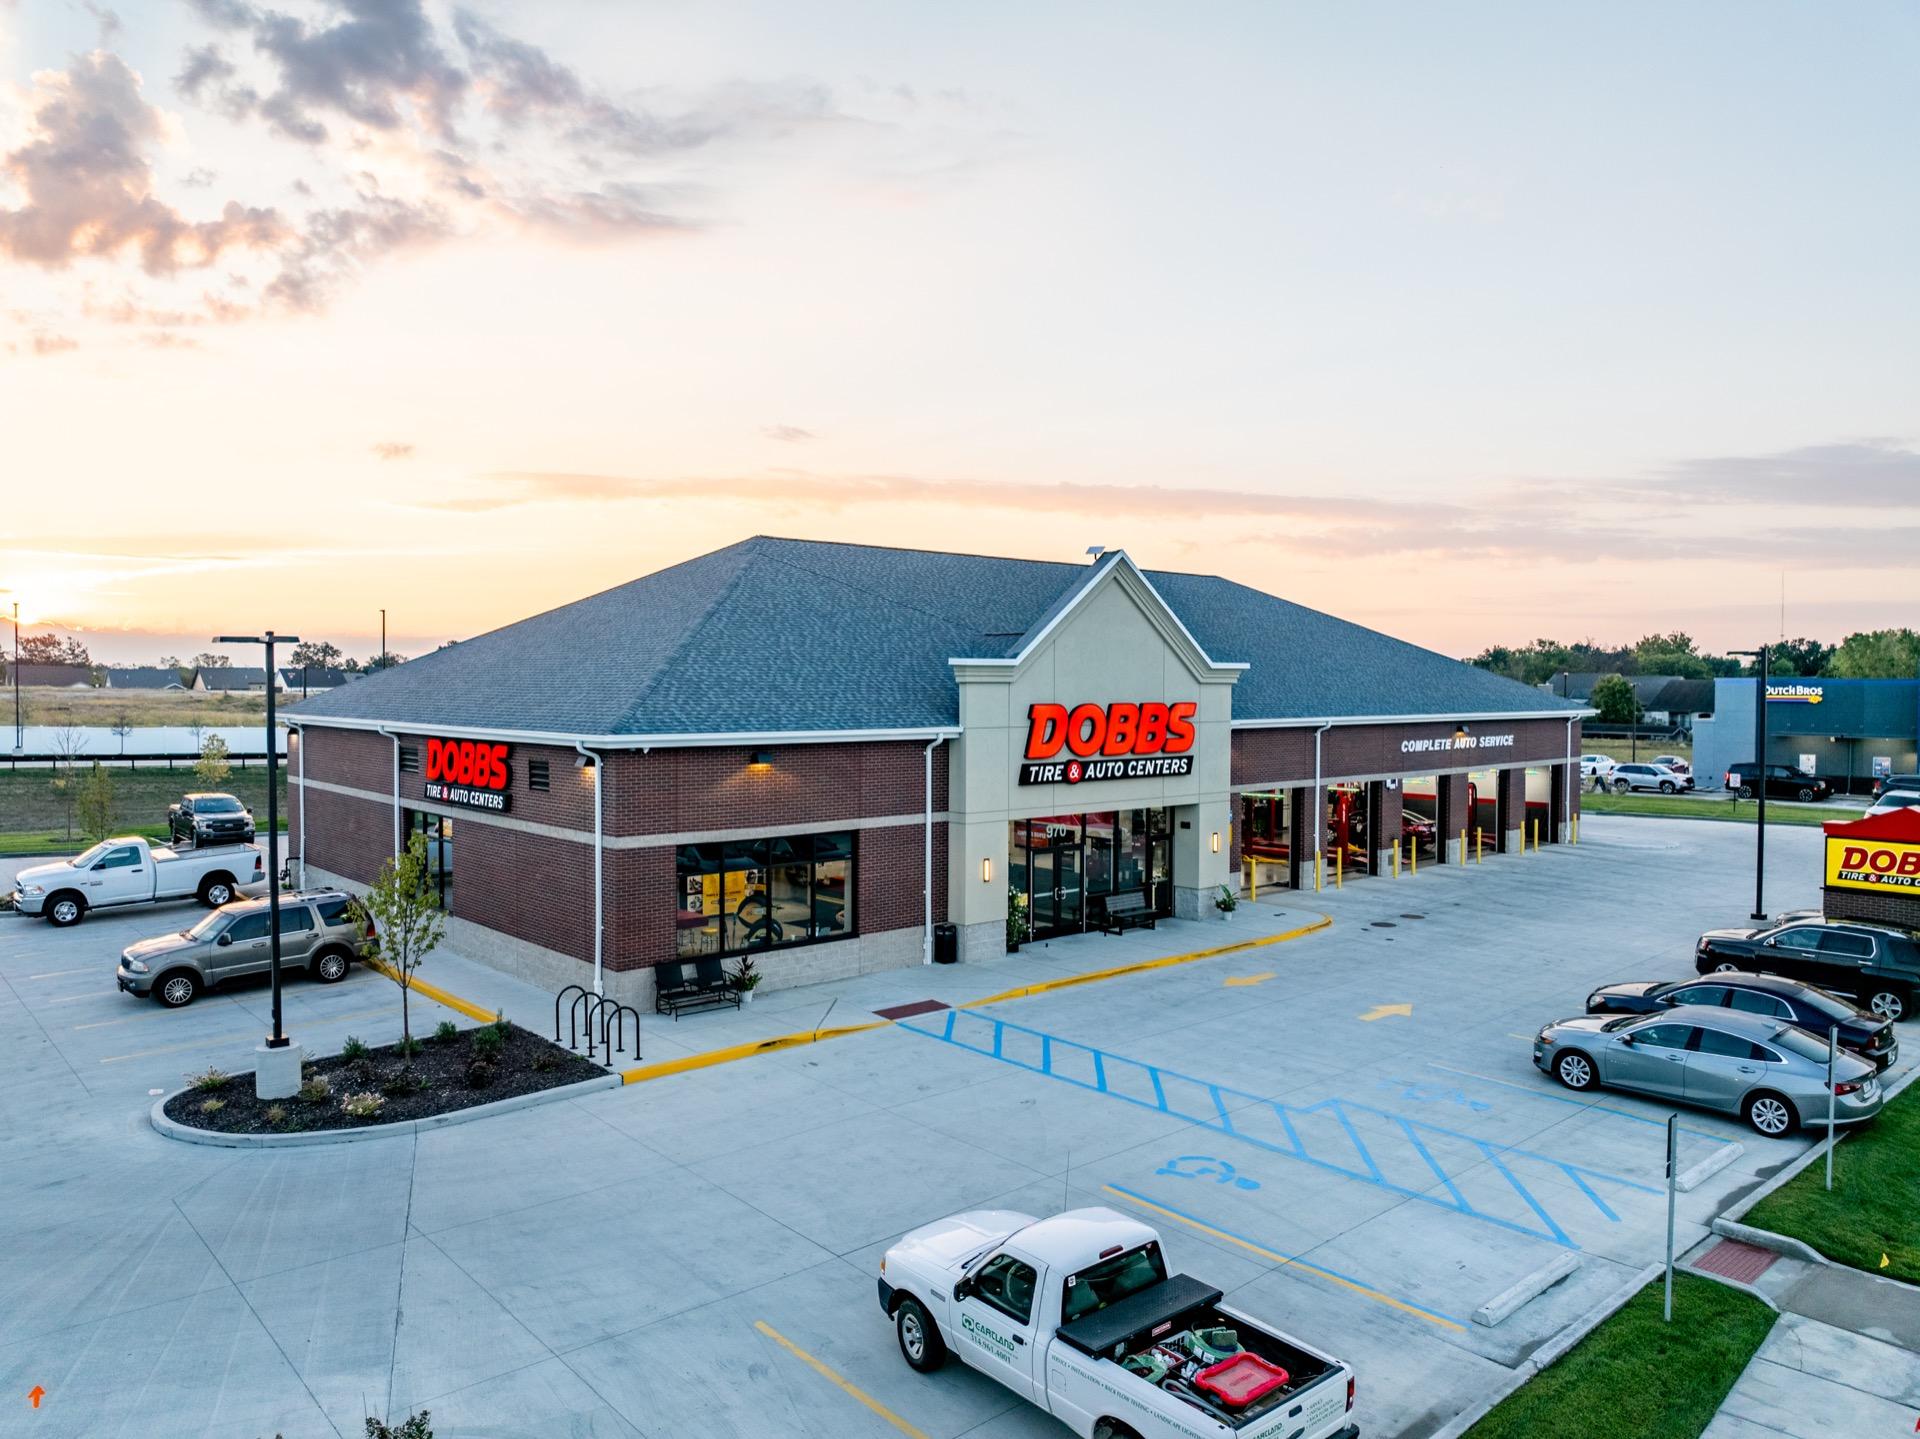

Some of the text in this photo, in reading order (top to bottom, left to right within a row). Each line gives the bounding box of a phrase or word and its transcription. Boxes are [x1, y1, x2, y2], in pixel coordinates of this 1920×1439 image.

[1024, 702, 1197, 759] DOBBS
[1401, 734, 1514, 753] COMPLETE AUTO SERVICE
[427, 739, 508, 790] DOBBS
[1029, 758, 1188, 783] TIRE & AUTO CENTERS
[426, 784, 504, 809] TIRE & AUTO CENTERS
[1046, 823, 1067, 838] 970
[1841, 871, 1866, 881] TIRE
[1869, 874, 1877, 882] &
[1881, 875, 1911, 885] AUTO
